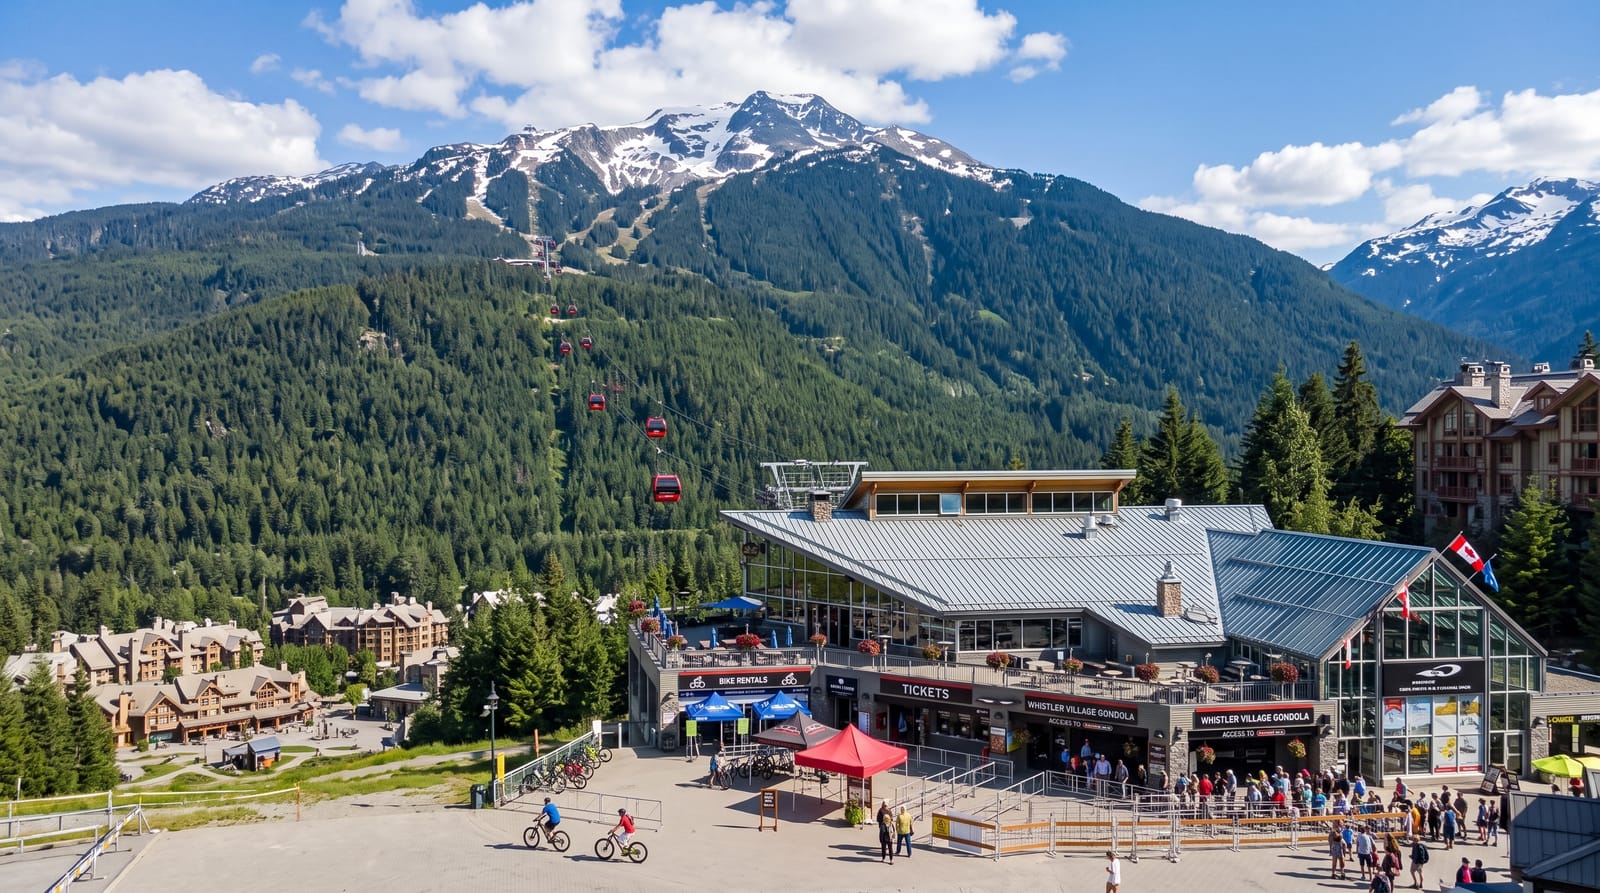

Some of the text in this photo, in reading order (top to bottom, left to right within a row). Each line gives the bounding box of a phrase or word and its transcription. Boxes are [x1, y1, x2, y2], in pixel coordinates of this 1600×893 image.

[719, 676, 768, 685] BIKE RENTALS
[902, 684, 950, 699] TICKETS
[1028, 701, 1135, 721] WHISTLER VILLAGE GONDOLA
[1201, 712, 1310, 725] WHISTLER VILLAGE GONDOLA
